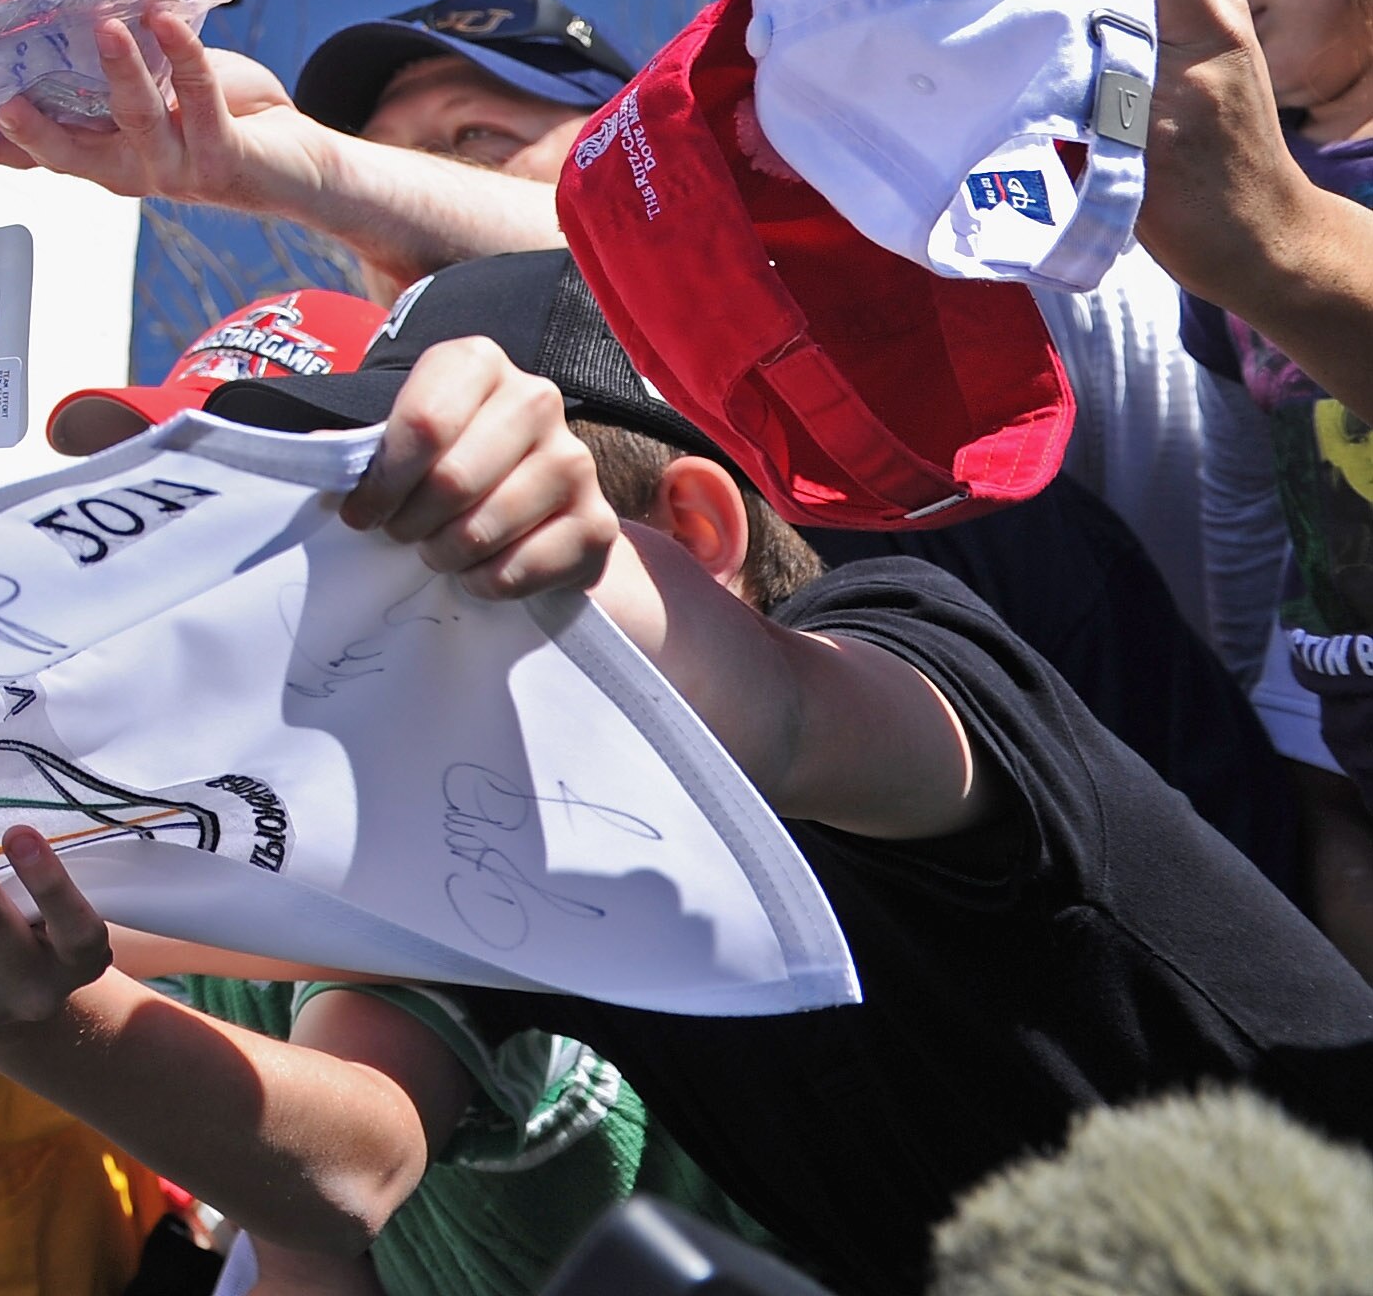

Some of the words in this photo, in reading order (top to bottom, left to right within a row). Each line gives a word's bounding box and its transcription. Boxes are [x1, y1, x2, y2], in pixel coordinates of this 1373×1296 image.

[632, 124, 656, 172] DOVE
[641, 185, 661, 221] THE
[2, 370, 10, 388] TEAM
[1, 391, 9, 419] EFFORT
